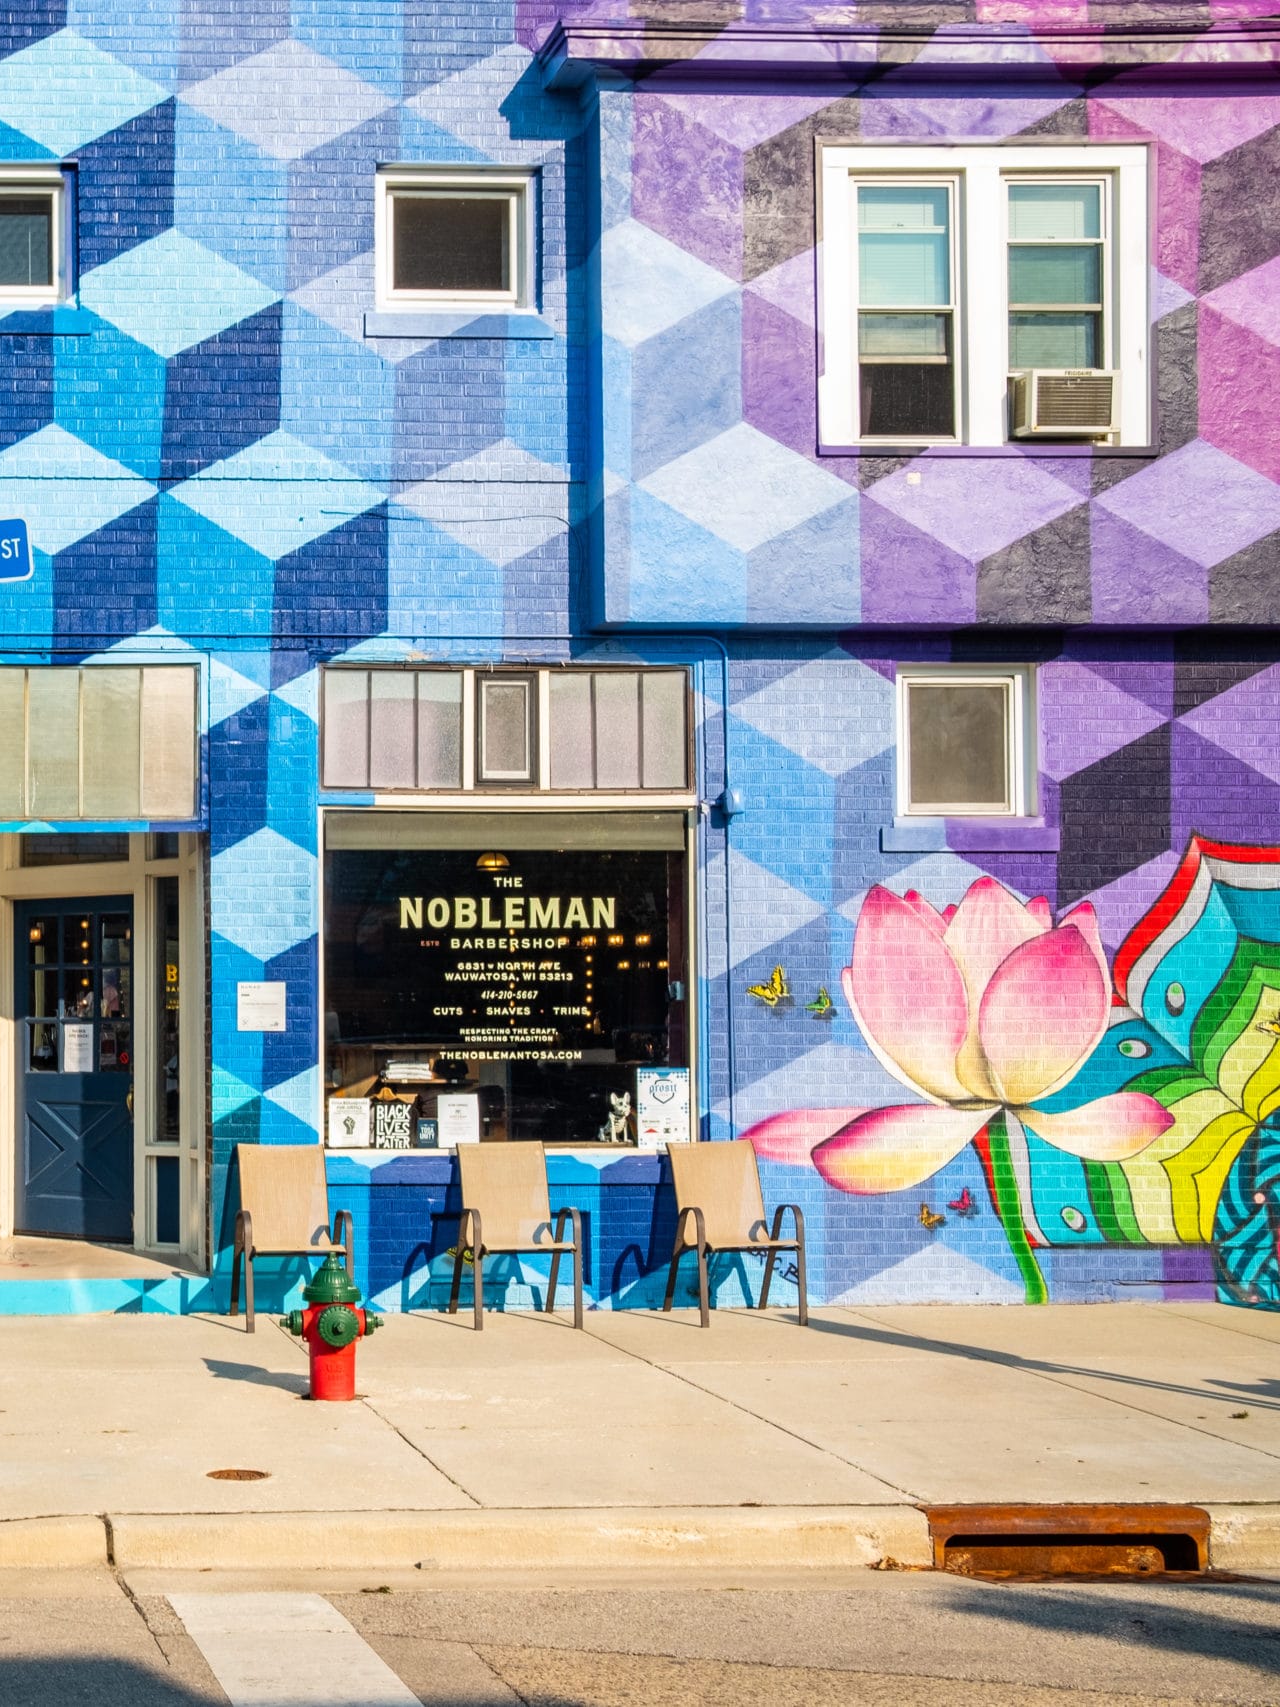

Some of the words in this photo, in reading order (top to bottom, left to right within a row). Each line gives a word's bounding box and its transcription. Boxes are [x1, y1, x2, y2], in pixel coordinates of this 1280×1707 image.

[1, 538, 20, 559] ST
[493, 877, 523, 888] THE
[399, 897, 616, 928] NOBLEMAN
[450, 938, 567, 949] BARBERSHOP
[497, 962, 535, 971] NORTH
[538, 962, 561, 970] AVE
[445, 972, 520, 982] WAUWATOSA,
[522, 973, 536, 981] WI
[539, 973, 574, 981] 53213
[481, 990, 539, 1000] 414-210-5667
[433, 1007, 463, 1016] CUTS
[486, 1007, 531, 1016] SHAVES
[553, 1007, 588, 1016] TRIMS
[530, 1028, 559, 1036] CRAFT,
[439, 1051, 582, 1060] THENOBLEMANTOSA.COM
[376, 1105, 411, 1121] BLACK
[376, 1119, 411, 1135] LIVES
[376, 1135, 410, 1149] MATTER
